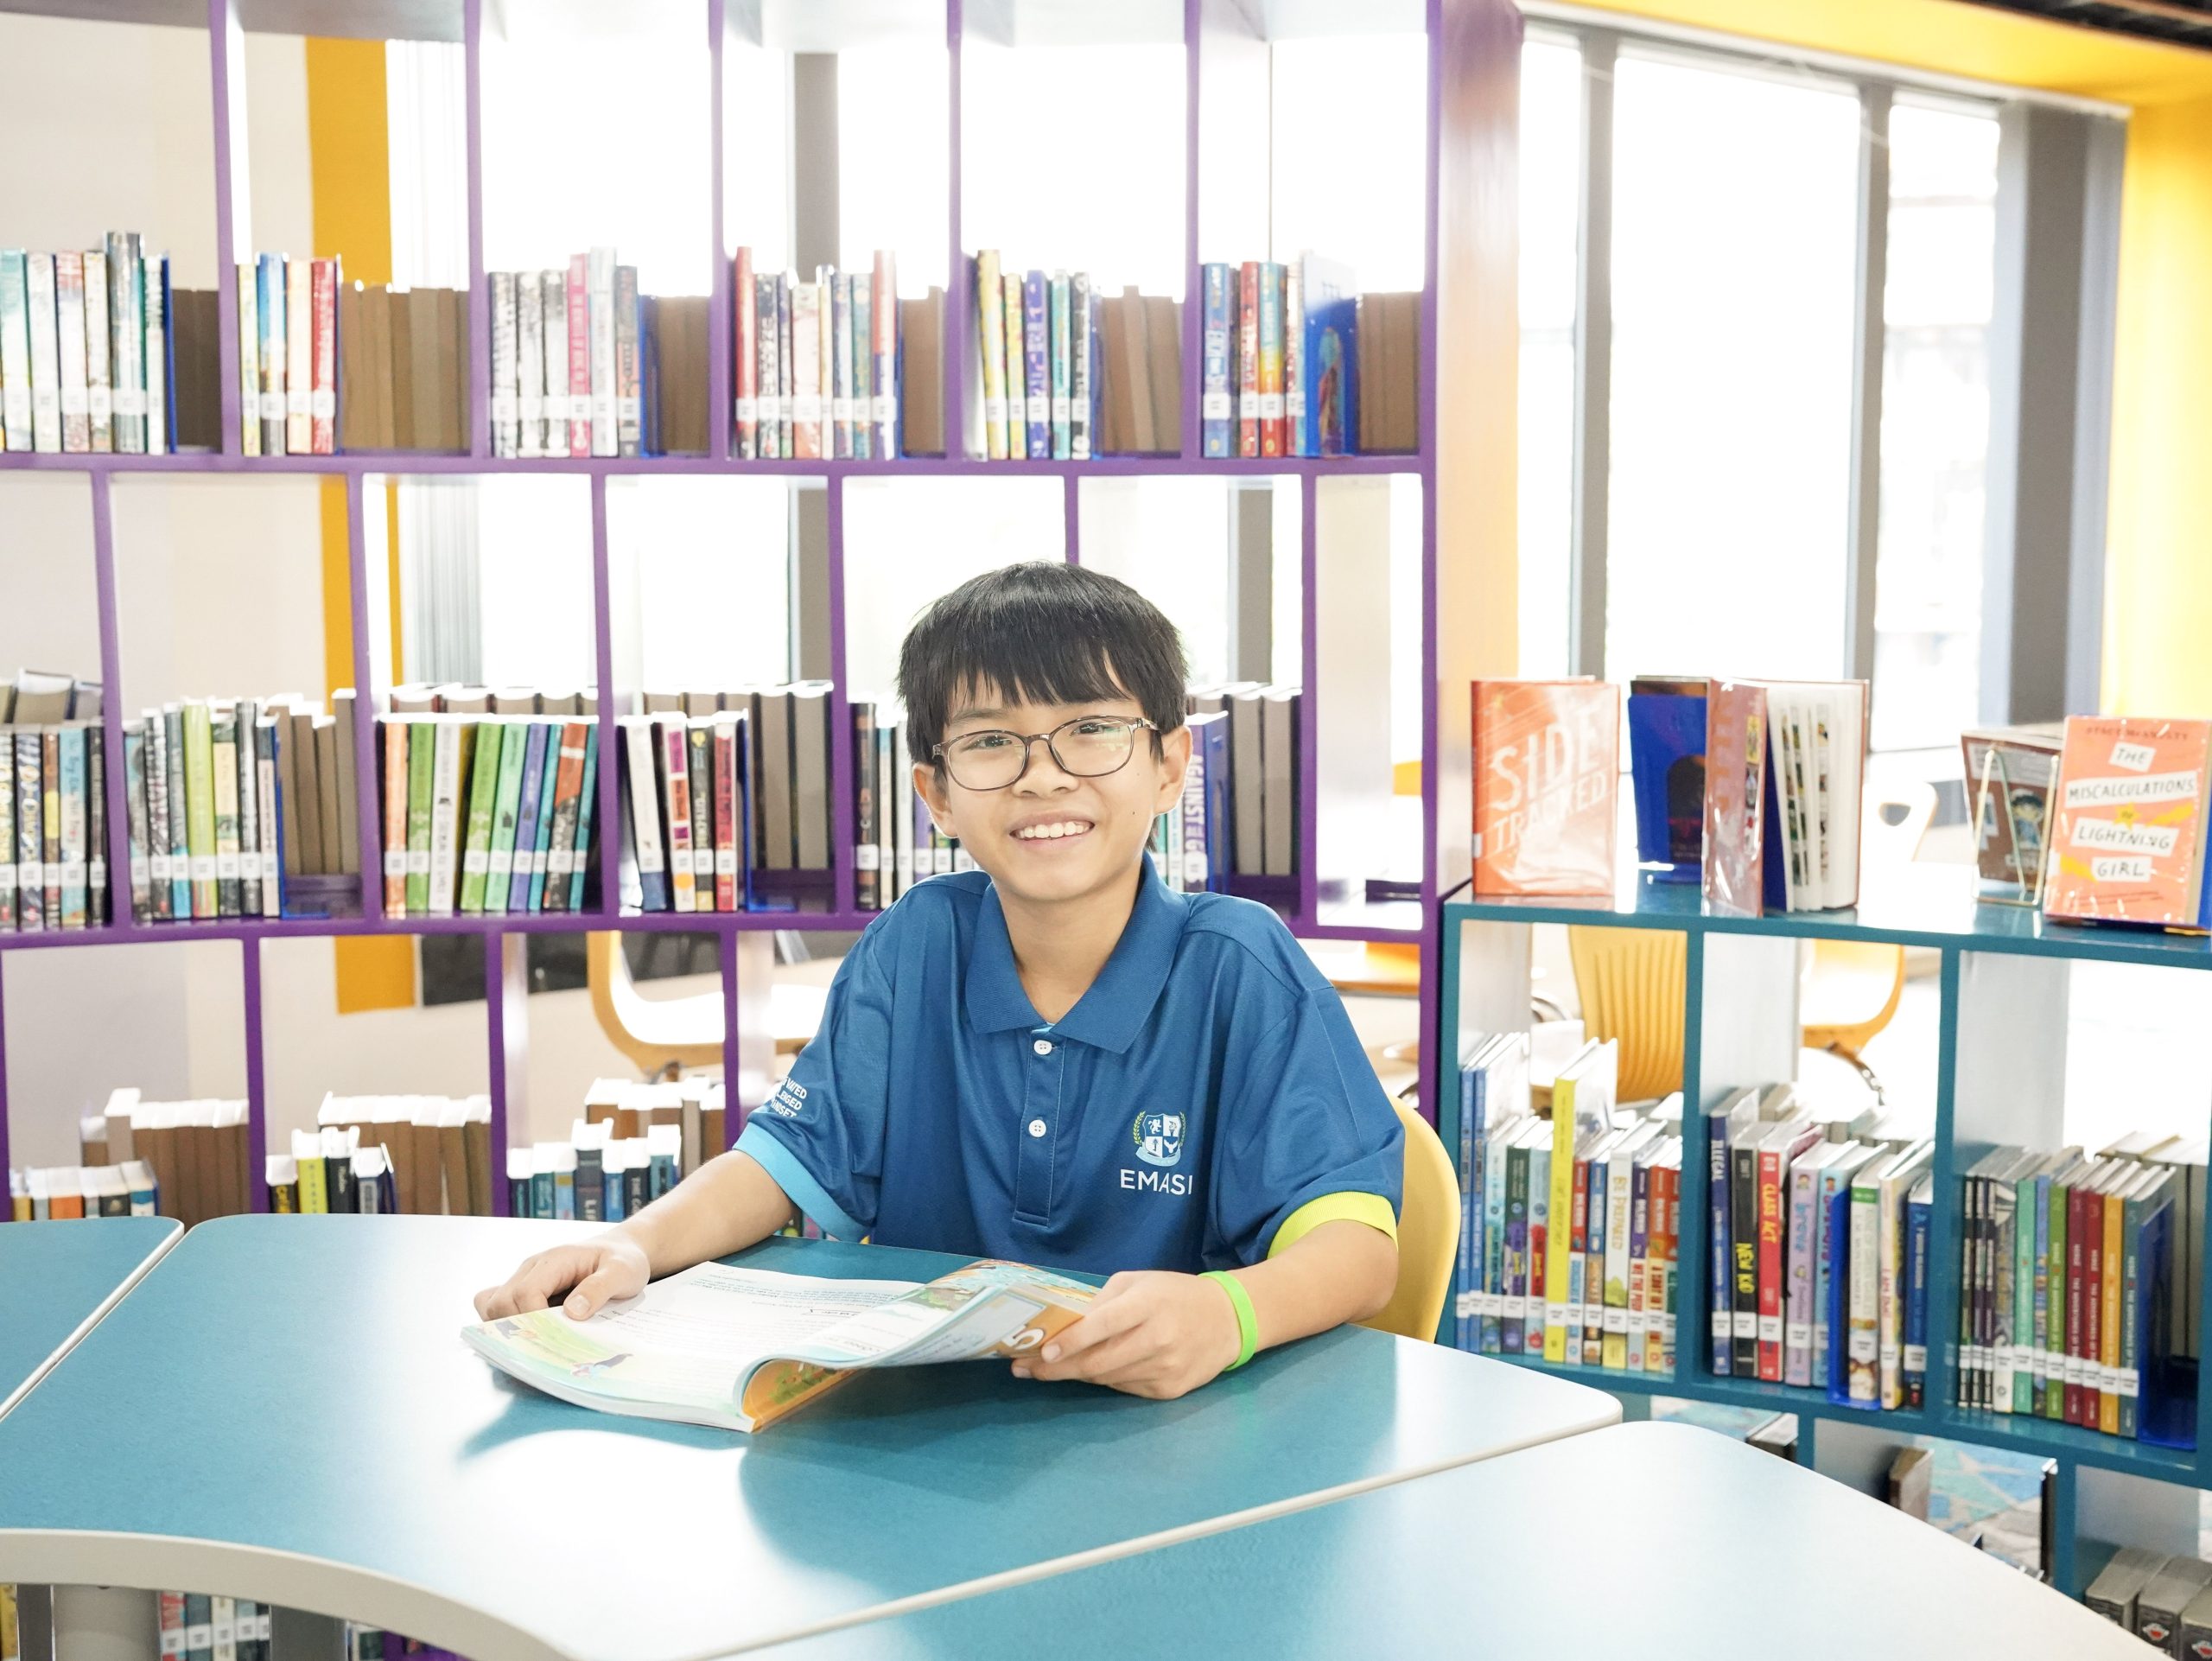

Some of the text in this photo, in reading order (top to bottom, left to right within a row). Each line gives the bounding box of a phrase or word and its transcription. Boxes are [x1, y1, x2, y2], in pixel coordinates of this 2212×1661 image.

[1488, 707, 1600, 811] SIDE
[2117, 748, 2147, 764] THE
[2069, 779, 2194, 800] MISCALCULATIONS
[2078, 826, 2170, 849] LIGHTNING
[2098, 862, 2145, 877] GIRL
[1121, 1169, 1192, 1195] EMASI
[1762, 1183, 1777, 1244] CLASS ACT
[1736, 1243, 1755, 1294] NEW KID
